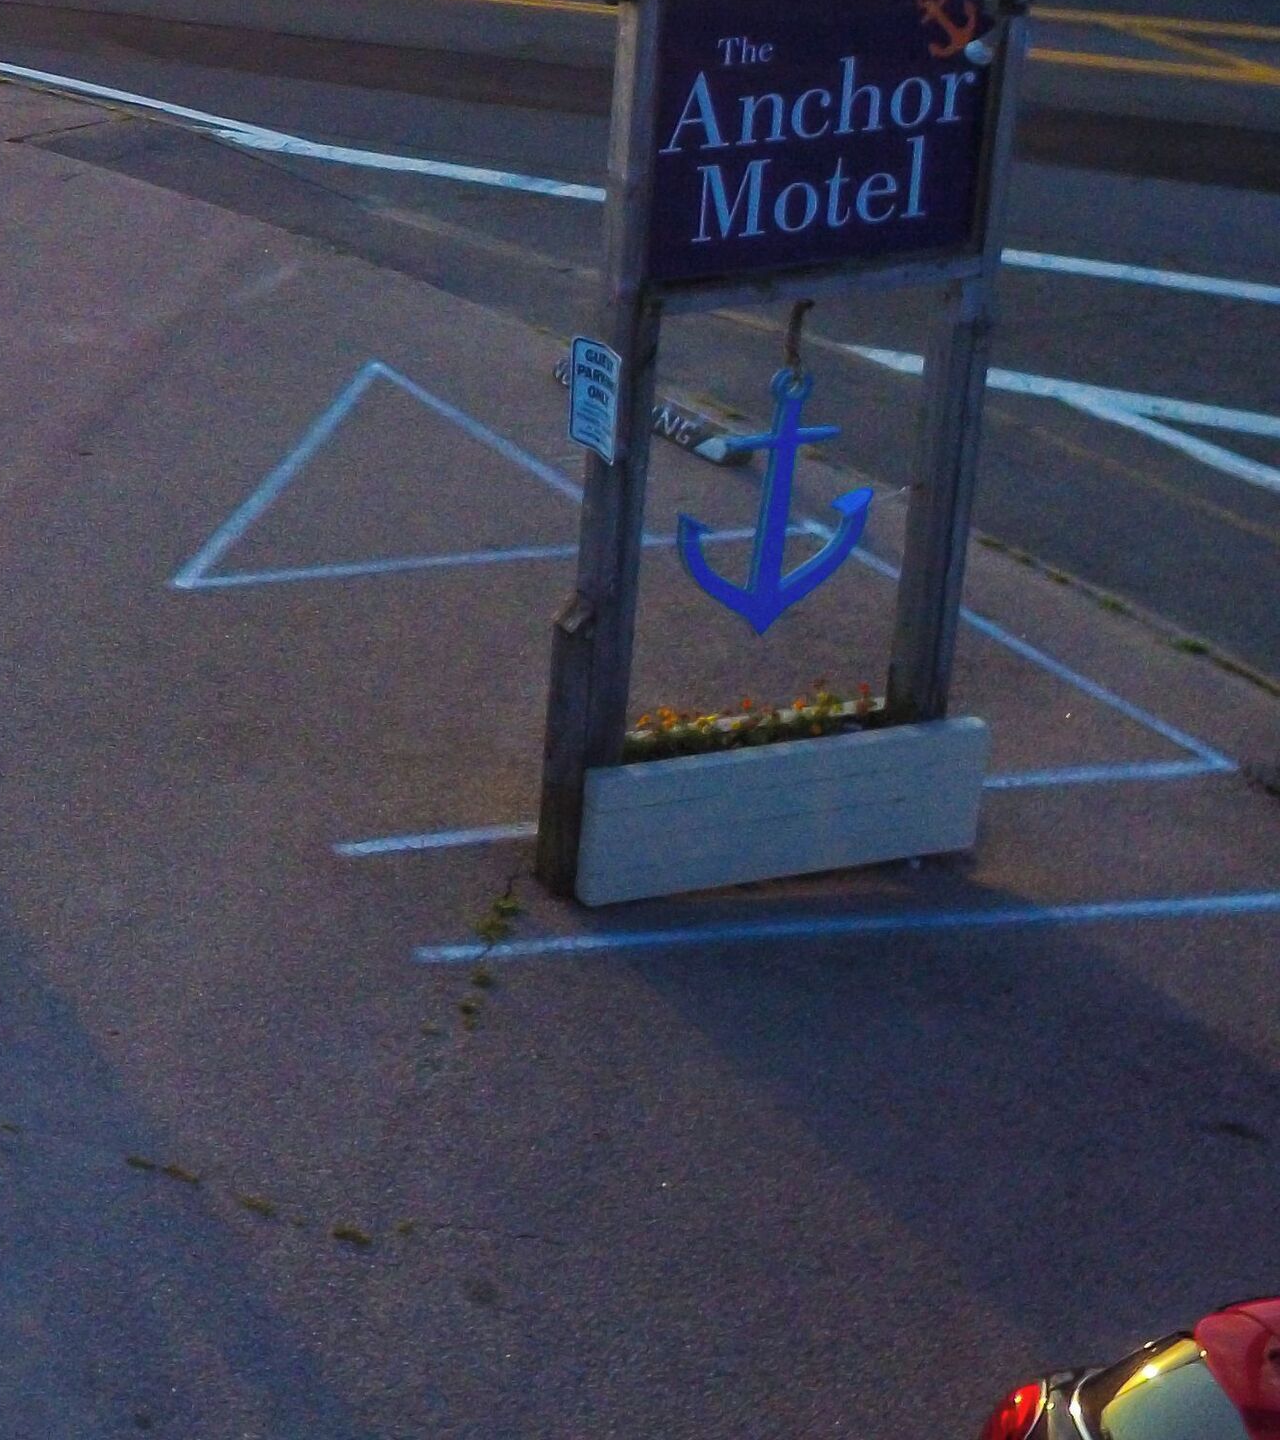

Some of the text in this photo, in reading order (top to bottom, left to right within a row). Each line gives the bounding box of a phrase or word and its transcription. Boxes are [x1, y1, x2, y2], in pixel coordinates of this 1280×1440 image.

[717, 35, 774, 65] The
[658, 55, 976, 153] Anchor
[691, 134, 927, 243] Motel
